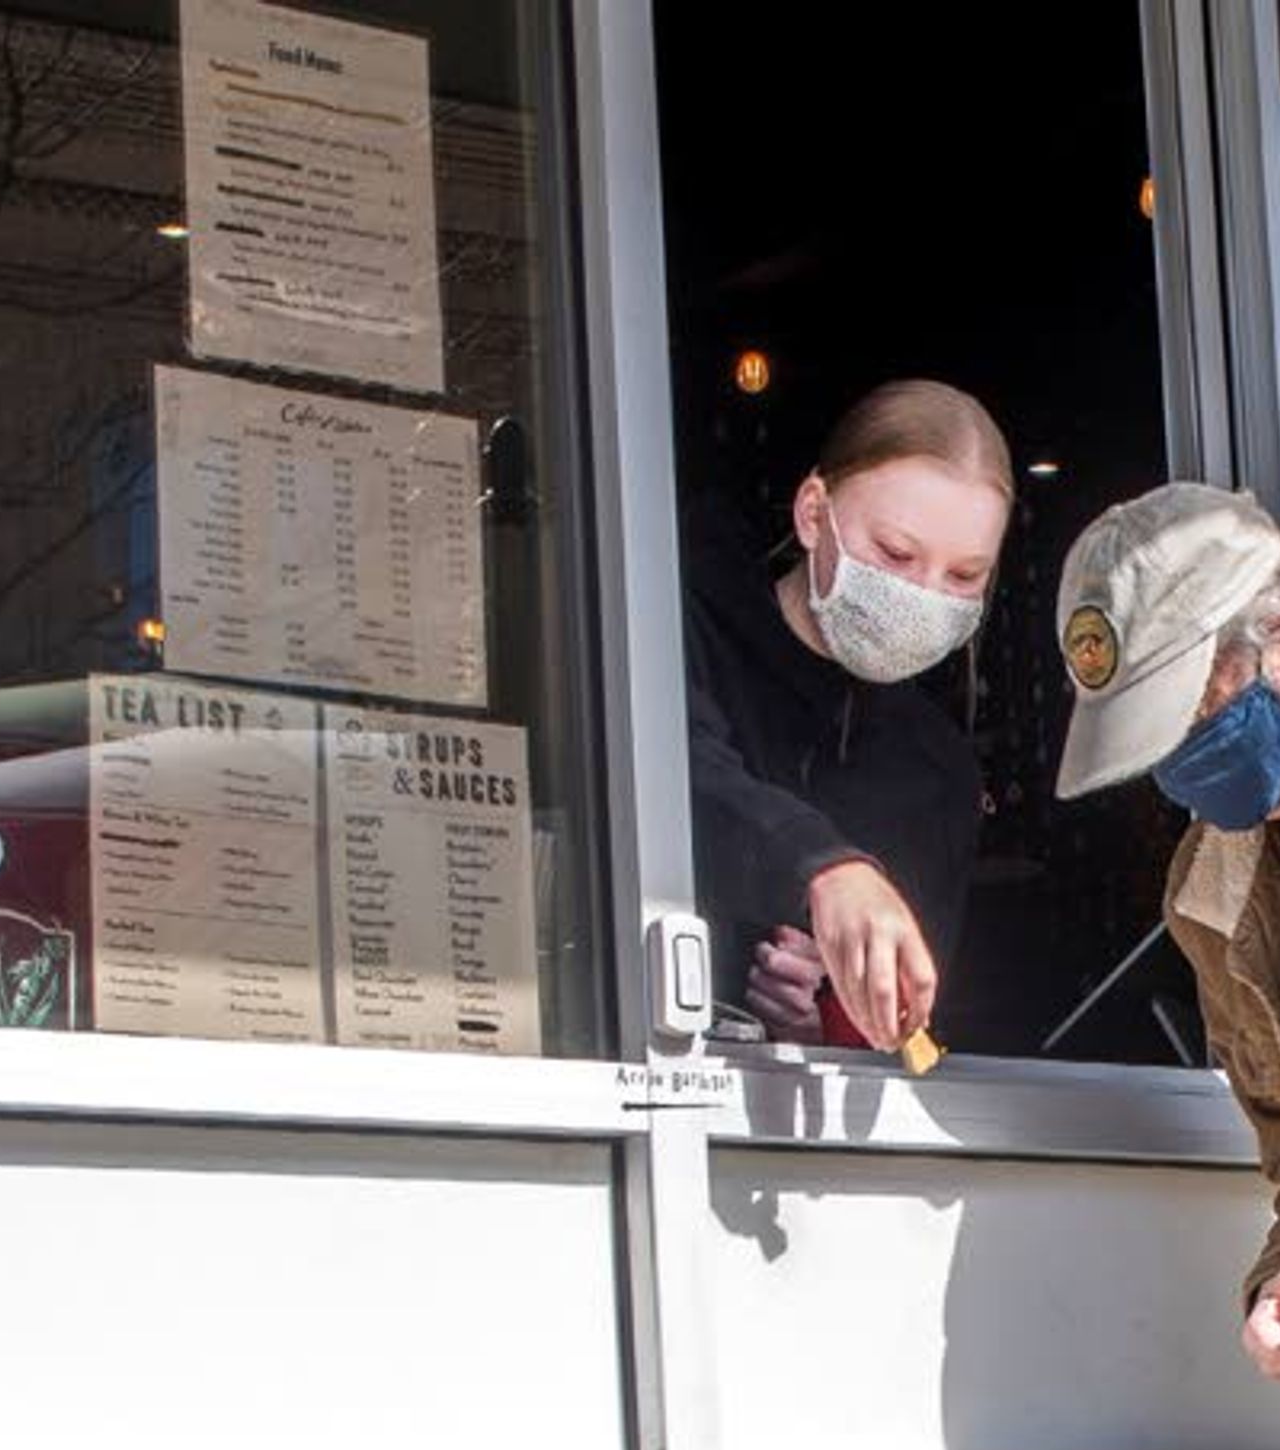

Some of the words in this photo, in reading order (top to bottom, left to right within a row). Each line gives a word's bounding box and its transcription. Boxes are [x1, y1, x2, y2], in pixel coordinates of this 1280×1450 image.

[102, 684, 160, 728] TEA
[176, 695, 246, 737] LIST
[393, 767, 414, 795] &
[418, 768, 517, 806] SAUCES
